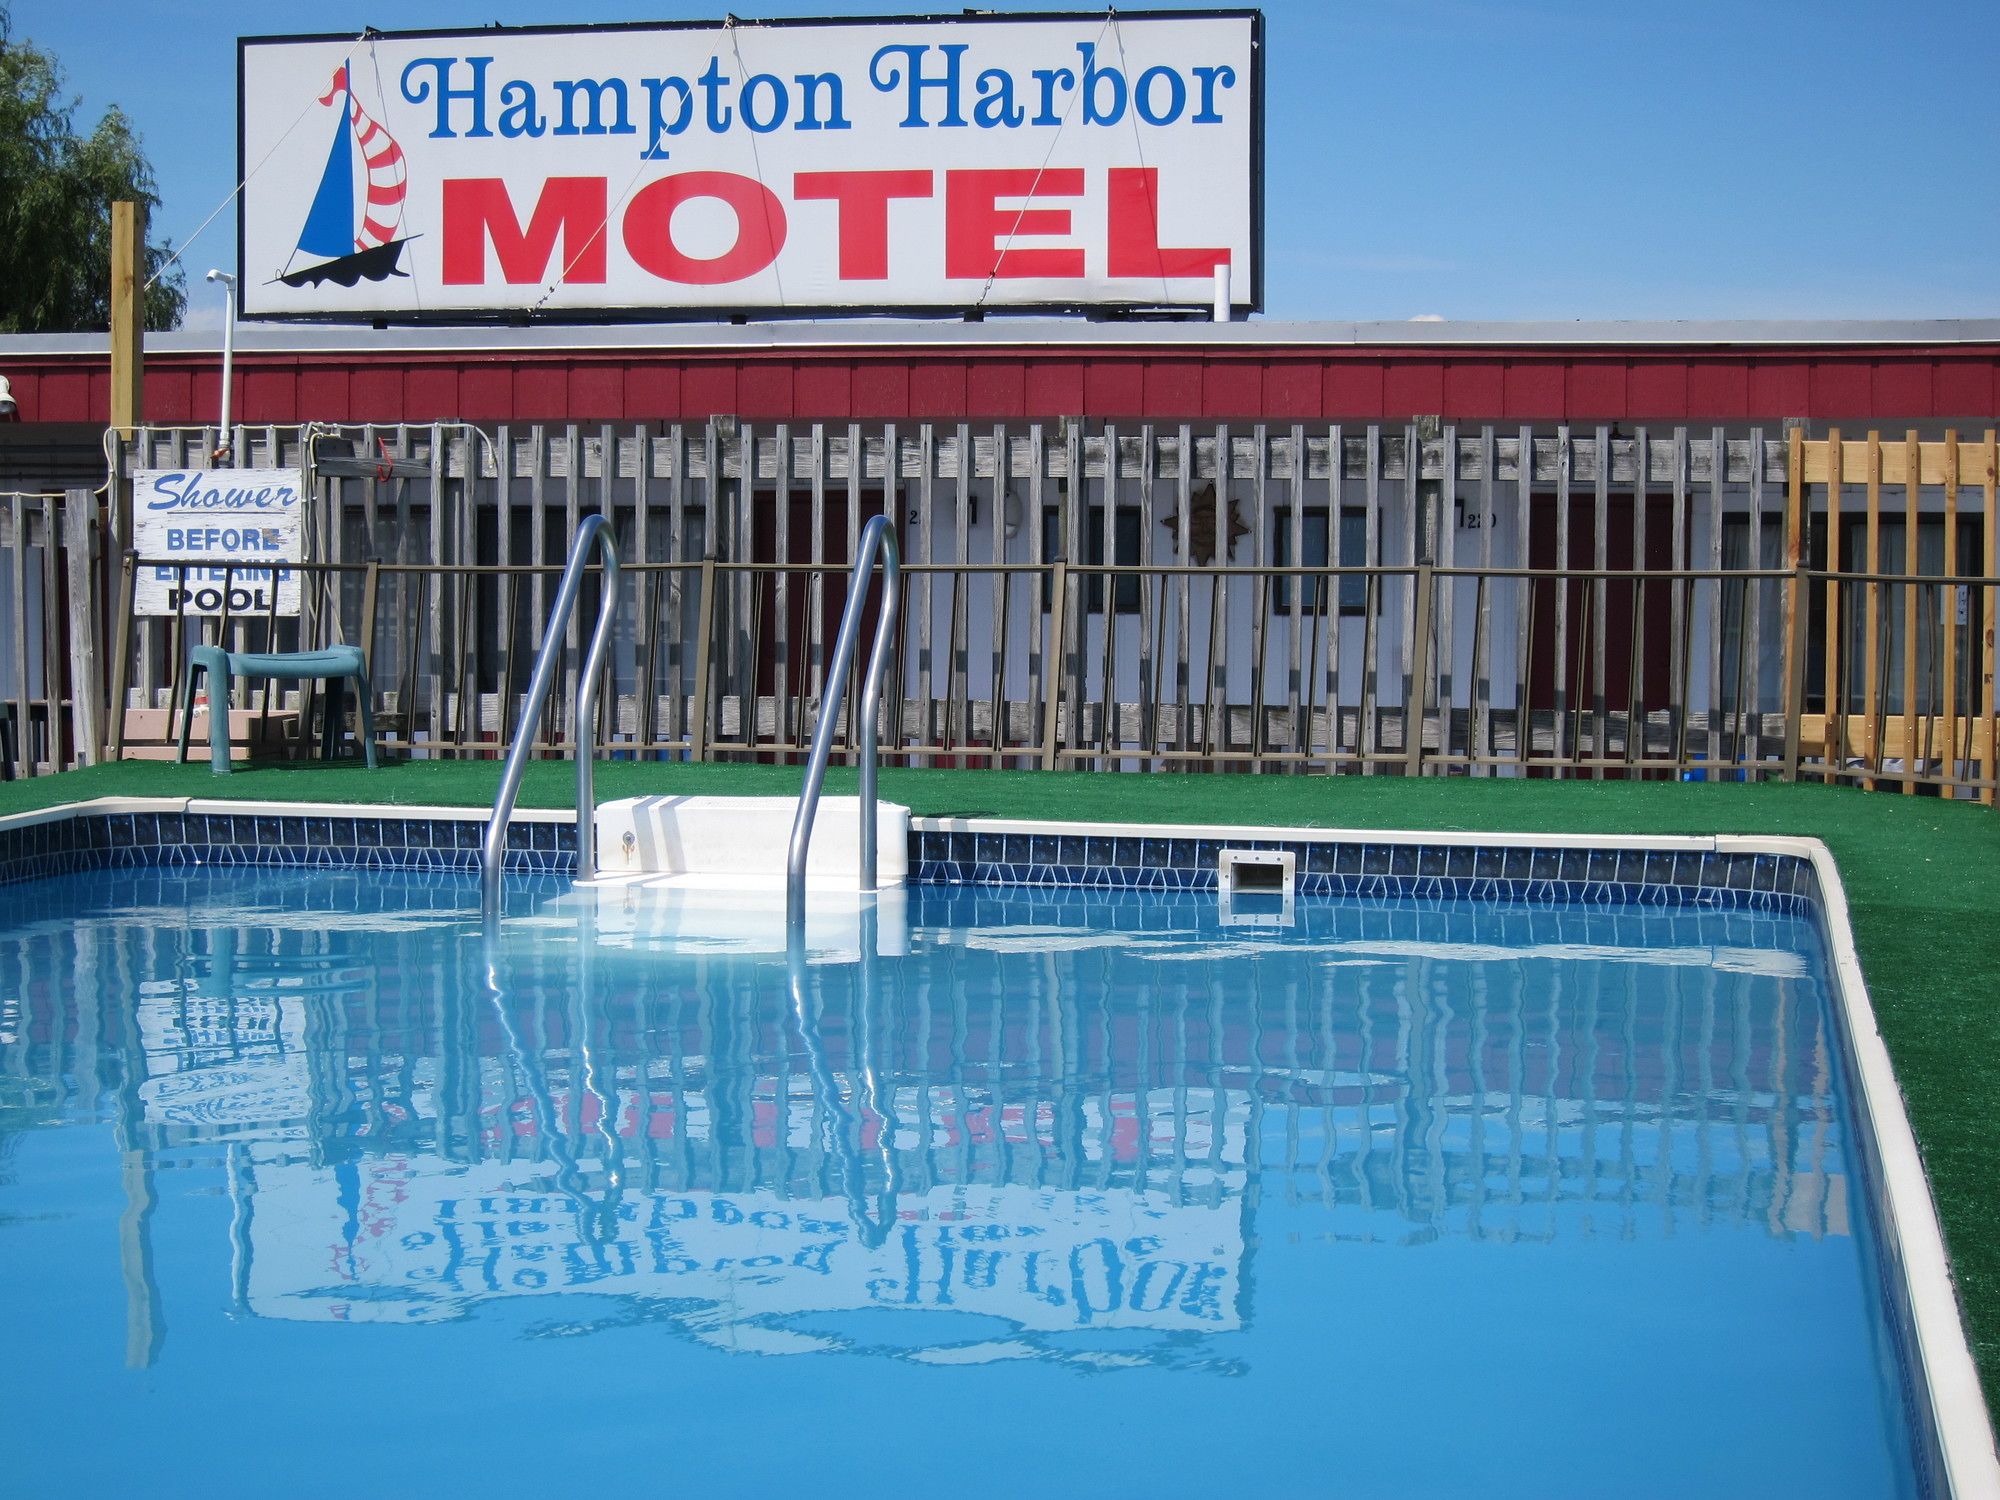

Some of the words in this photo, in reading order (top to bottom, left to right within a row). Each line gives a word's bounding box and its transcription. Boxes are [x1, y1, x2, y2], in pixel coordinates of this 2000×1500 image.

[400, 57, 851, 160] Hampton
[869, 42, 1235, 129] Harbor
[442, 168, 1231, 285] MOTEL
[147, 472, 298, 510] Shower
[167, 528, 280, 552] BEFORE
[168, 588, 272, 611] POOL
